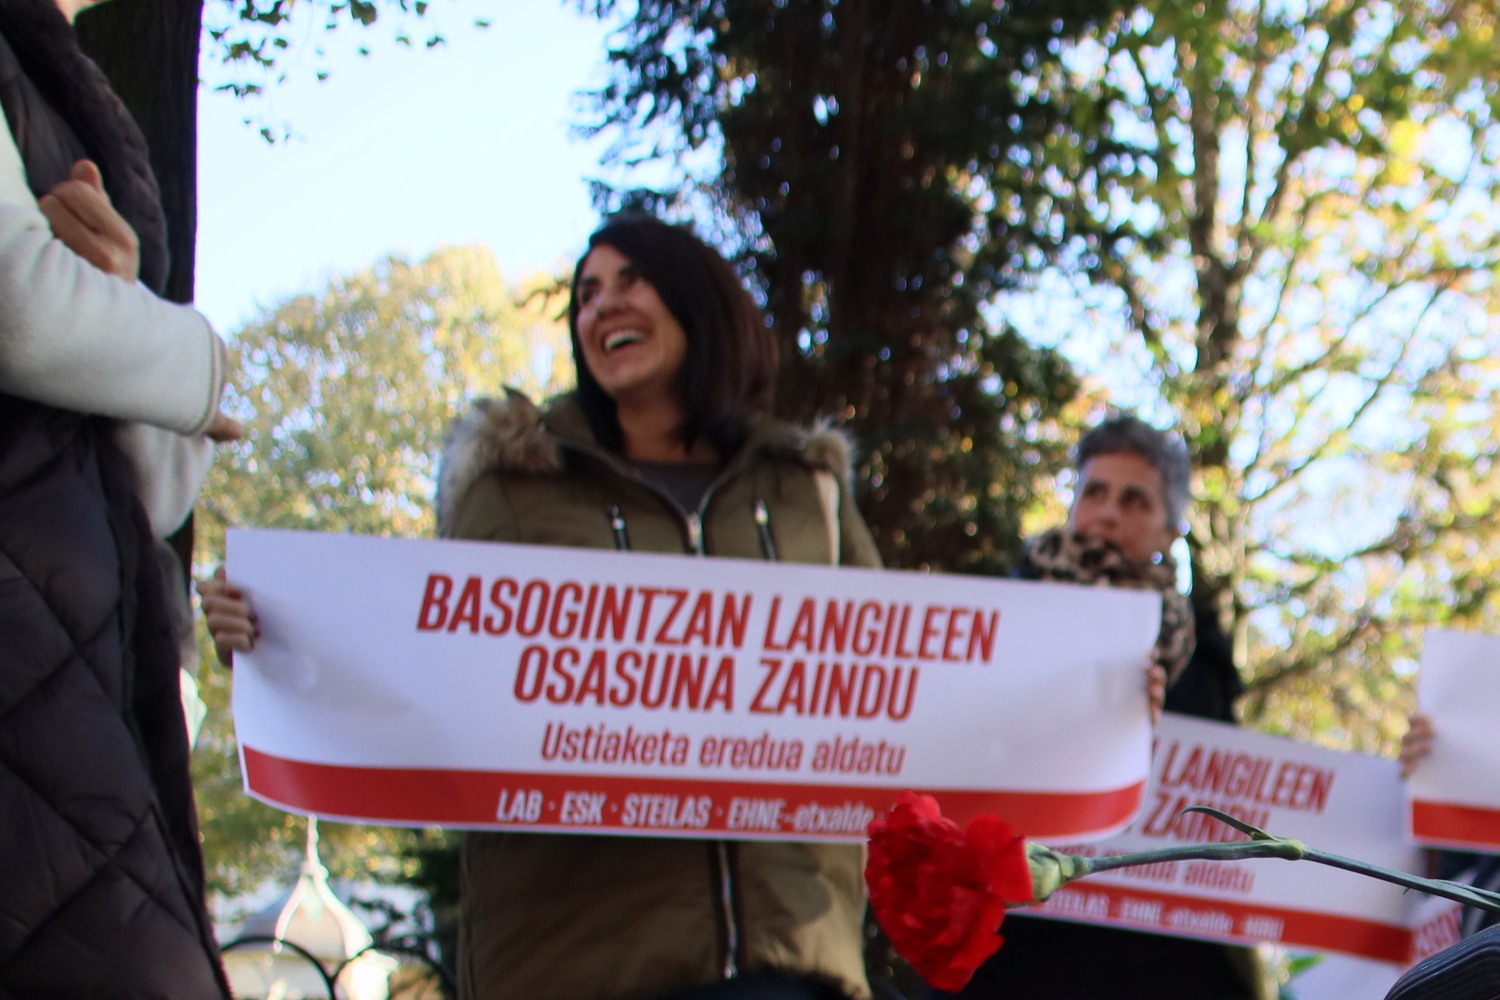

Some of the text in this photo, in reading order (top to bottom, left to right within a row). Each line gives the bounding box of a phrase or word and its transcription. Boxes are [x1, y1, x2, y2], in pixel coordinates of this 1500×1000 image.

[417, 571, 1000, 663] BASOGINTZAN LANGILEEN
[513, 645, 919, 722] OSASUNA ZAINDU
[541, 721, 907, 776] Ustiaketa eredua aldatu
[1160, 741, 1336, 815] LANGILEEN
[496, 788, 543, 823] LAB
[559, 790, 606, 825] ESK
